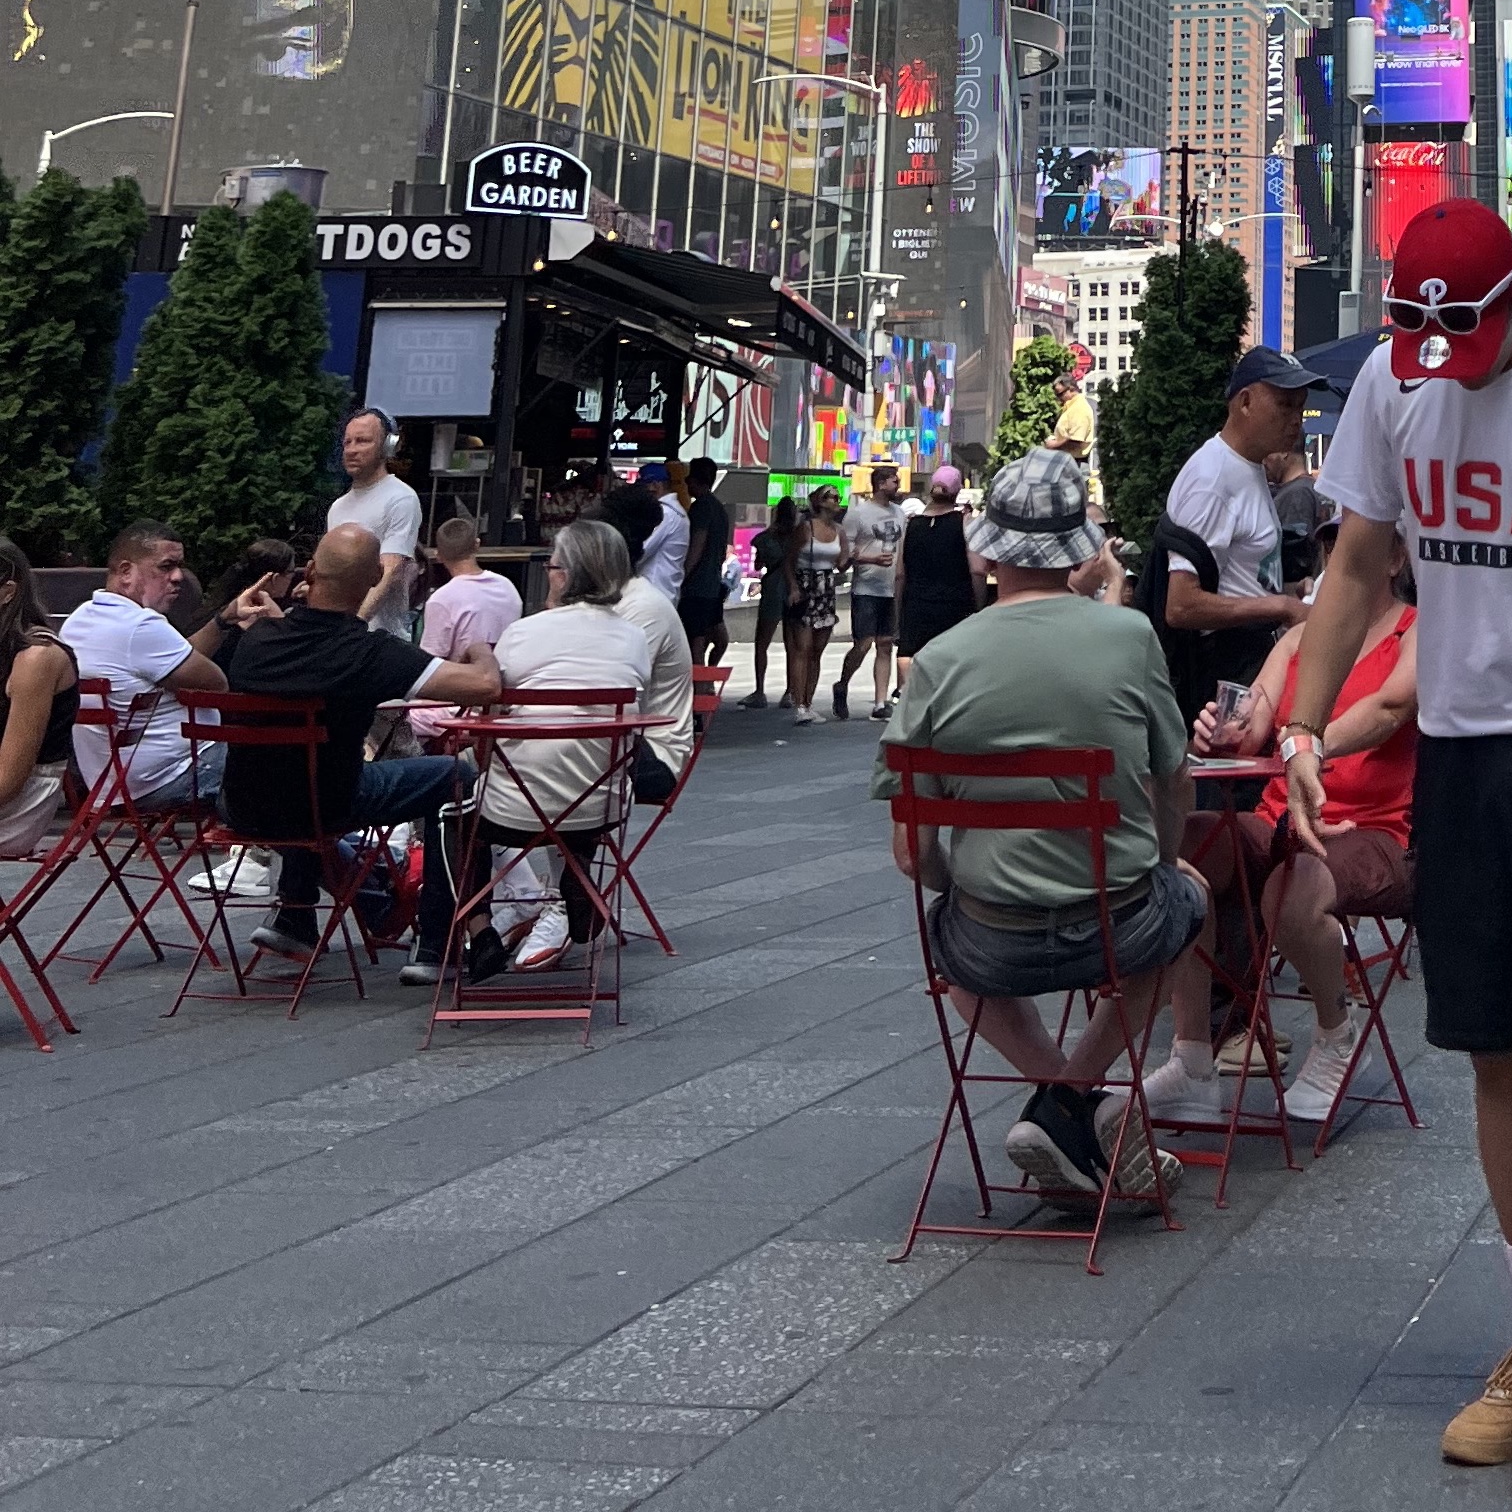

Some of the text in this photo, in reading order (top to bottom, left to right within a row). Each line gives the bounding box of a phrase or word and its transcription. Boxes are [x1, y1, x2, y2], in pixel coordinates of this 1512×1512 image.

[672, 10, 744, 121] LION
[1387, 61, 1412, 69] wow
[914, 123, 935, 137] THE
[907, 138, 941, 154] SHOW
[503, 152, 562, 179] BEER
[911, 154, 926, 168] OF
[480, 182, 577, 210] GARDEN
[316, 223, 472, 261] TDOGS
